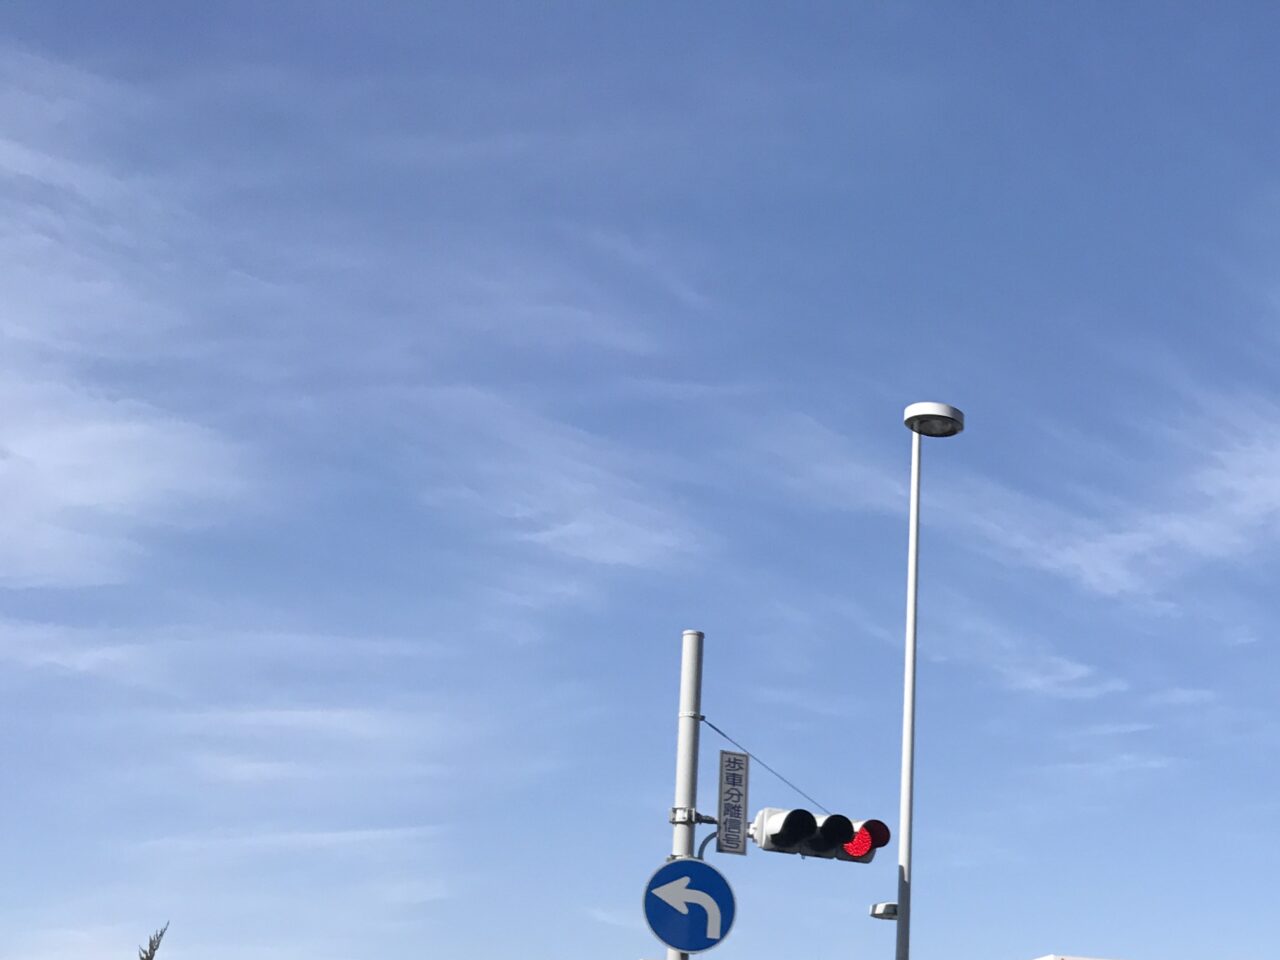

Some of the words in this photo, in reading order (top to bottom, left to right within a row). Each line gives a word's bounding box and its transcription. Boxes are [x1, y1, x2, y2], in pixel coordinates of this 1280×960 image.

[723, 757, 743, 849] 歩車分離信号
